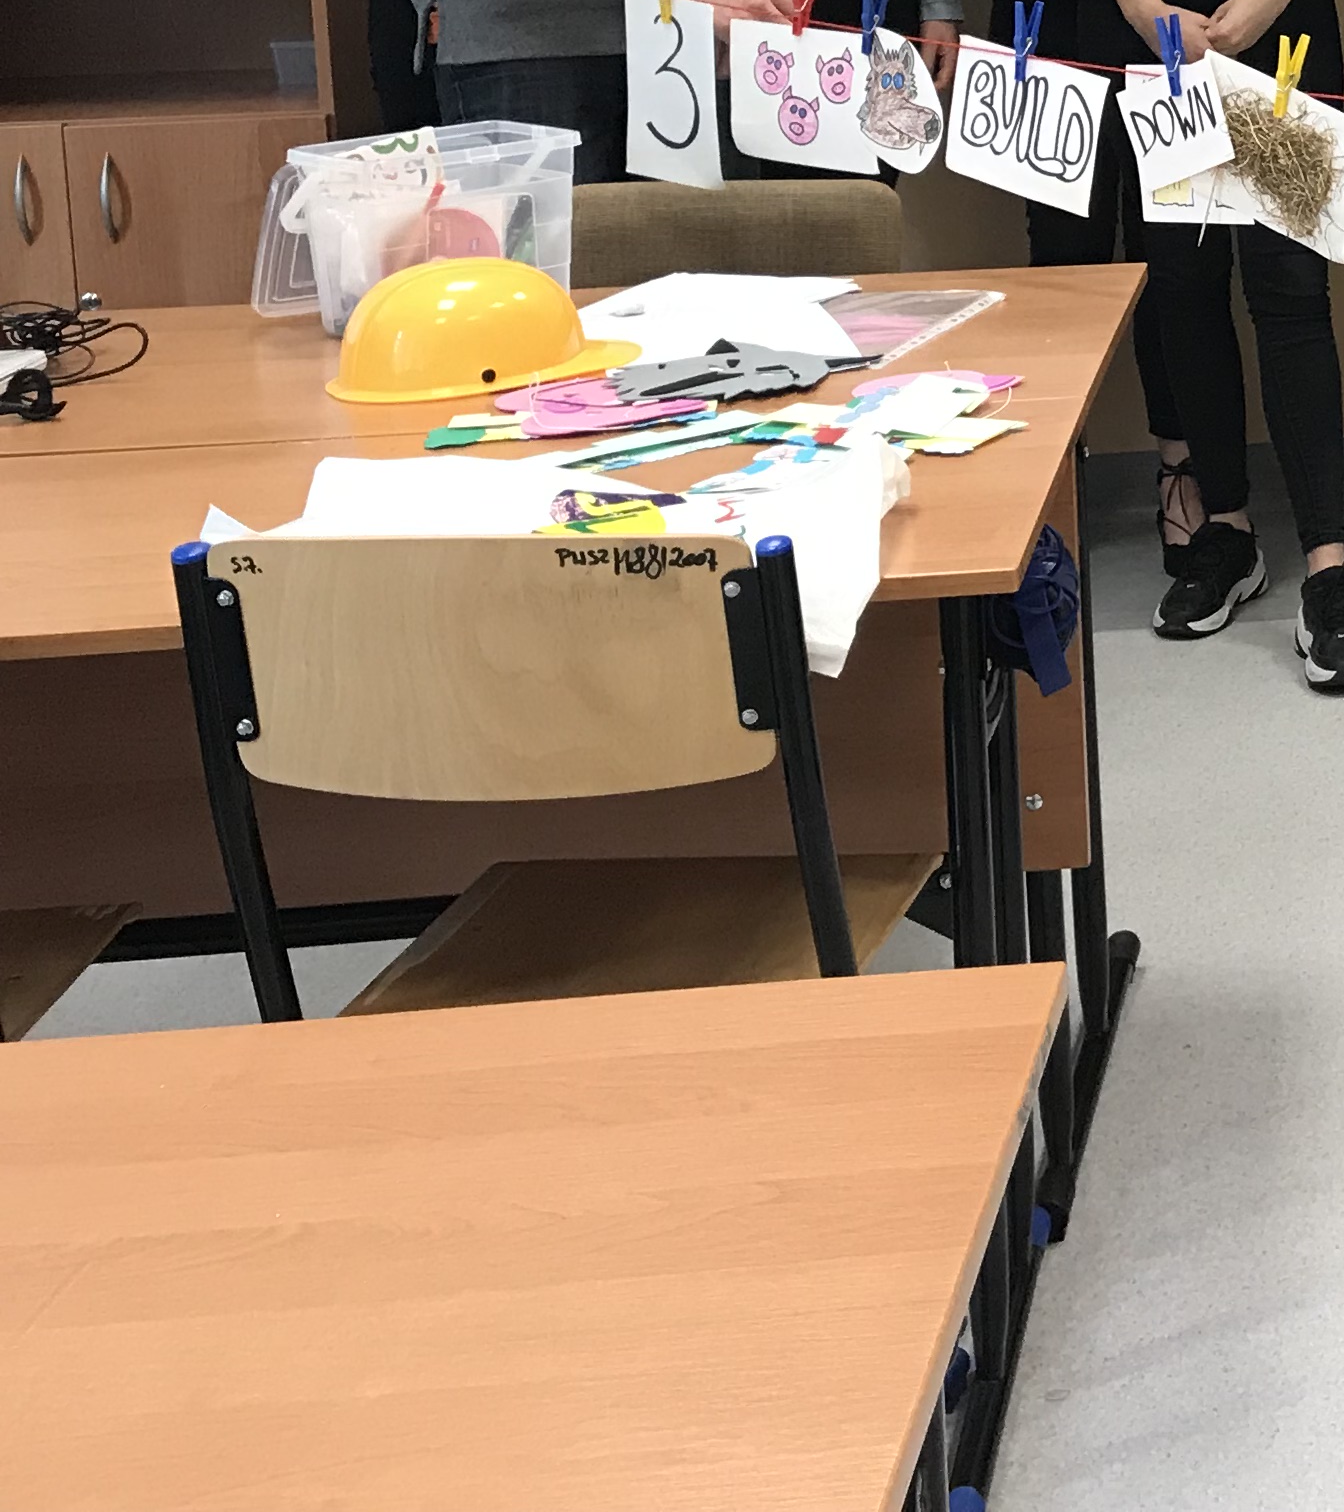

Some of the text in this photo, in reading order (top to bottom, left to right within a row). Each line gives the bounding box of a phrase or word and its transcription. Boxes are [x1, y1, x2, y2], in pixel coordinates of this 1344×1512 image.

[646, 13, 701, 150] 3
[960, 59, 1094, 182] BUILD
[1129, 80, 1217, 158] DOWN
